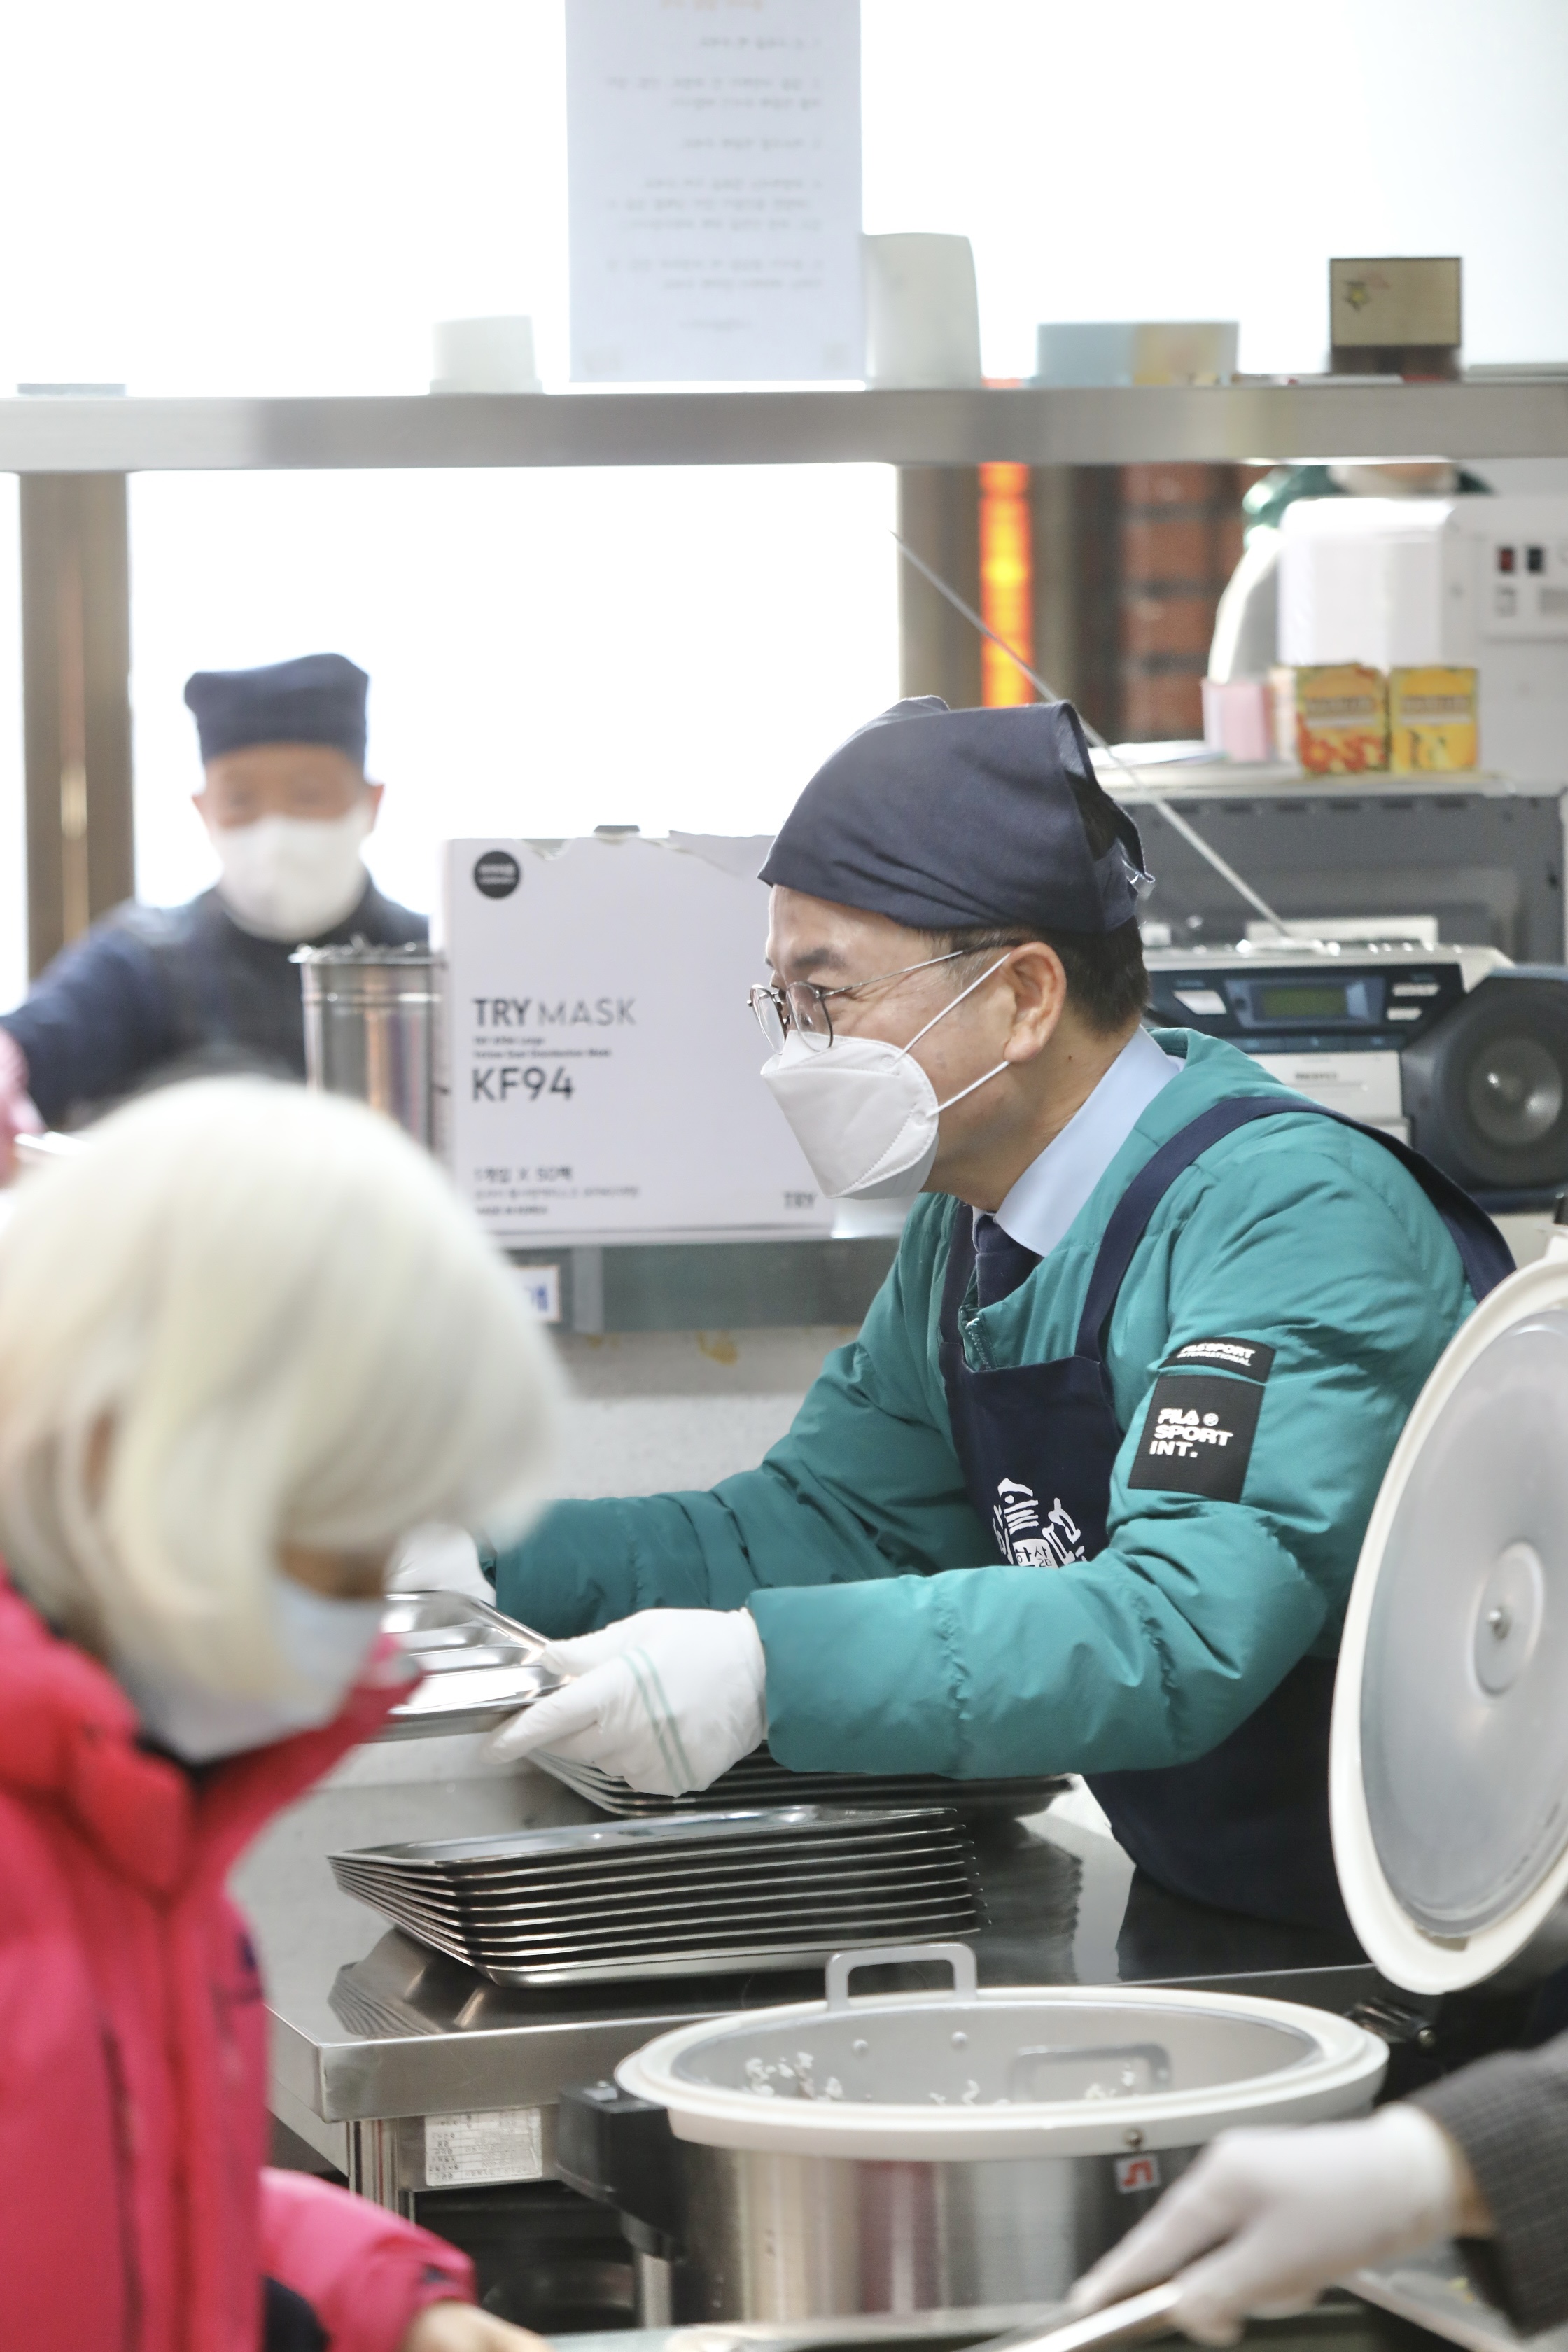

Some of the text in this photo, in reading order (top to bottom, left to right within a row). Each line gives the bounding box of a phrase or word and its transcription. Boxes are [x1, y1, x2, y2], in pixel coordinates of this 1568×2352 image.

[472, 997, 636, 1026] TRY MASK
[472, 1066, 574, 1102] KF94
[783, 1191, 818, 1210] TRY
[1205, 1343, 1256, 1359] SPORT
[1158, 1408, 1200, 1425] FILA
[1154, 1424, 1233, 1446] SPORT
[1149, 1440, 1198, 1458] INT.
